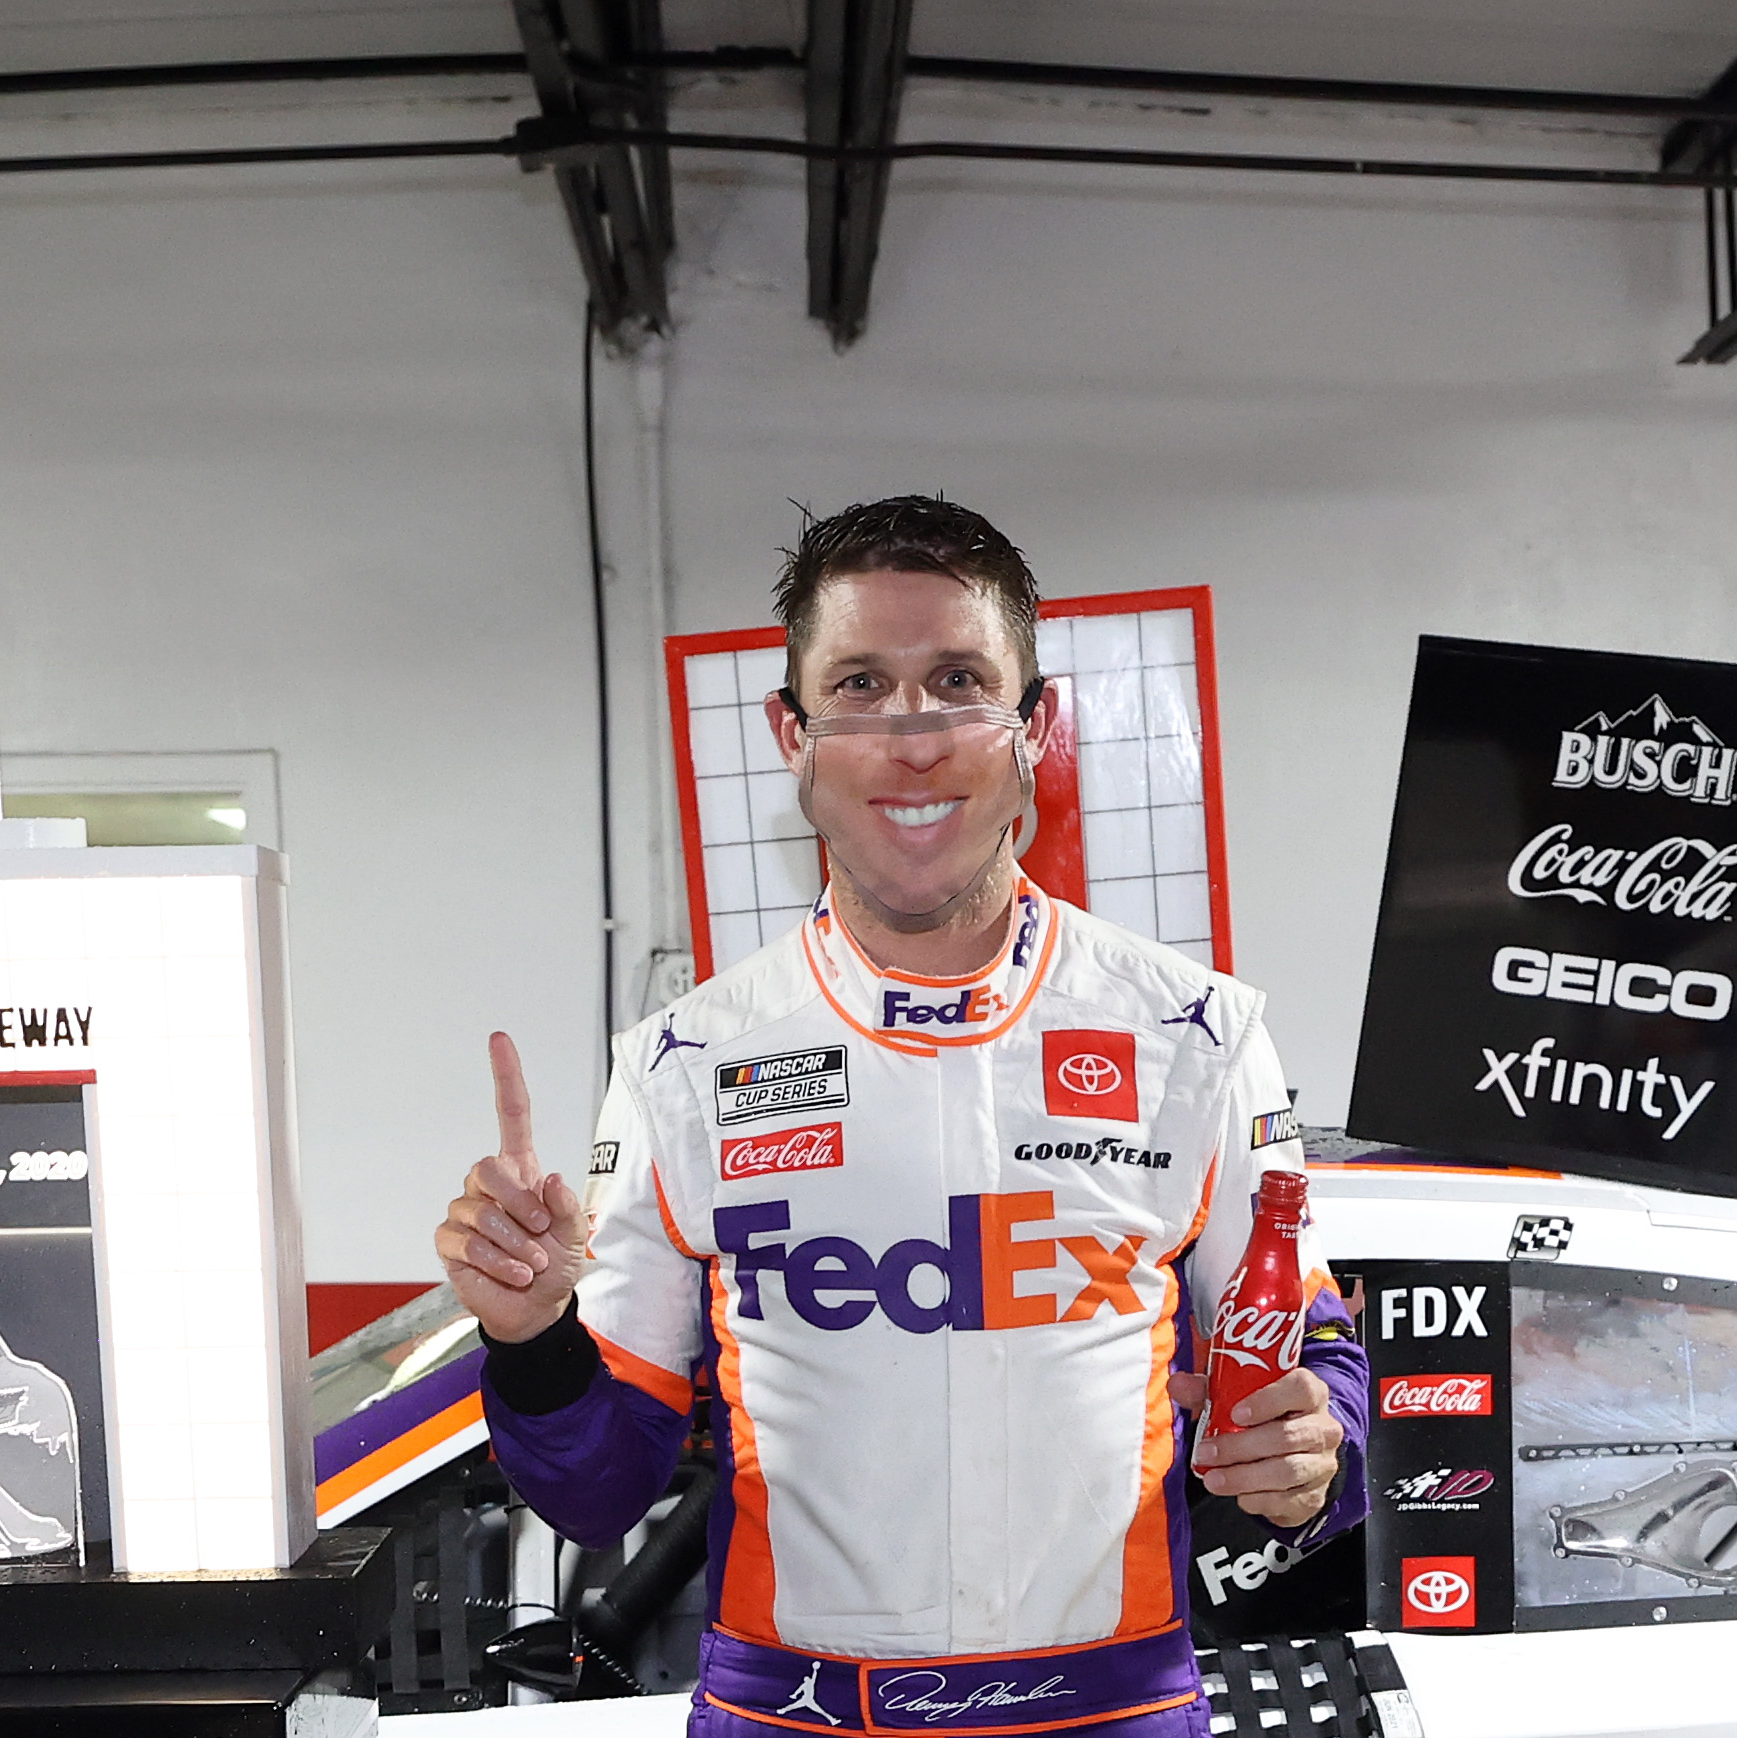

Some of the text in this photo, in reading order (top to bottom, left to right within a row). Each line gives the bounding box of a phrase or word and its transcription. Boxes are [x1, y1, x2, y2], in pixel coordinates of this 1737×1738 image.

[1491, 946, 1733, 1021] GEICO
[883, 985, 1008, 1027] FedEx
[756, 1051, 826, 1081] NASCAR
[735, 1078, 828, 1109] CUP SERIES
[1475, 1037, 1715, 1140] xfinity
[1270, 1111, 1299, 1141] NAS
[9, 1151, 88, 1181] 2020
[724, 1128, 836, 1176] Coca-Cola
[1015, 1142, 1171, 1170] GOODYEAR
[713, 1190, 1147, 1333] FedEx
[1381, 1286, 1488, 1340] FDX
[1383, 1379, 1488, 1414] Coca-Cola
